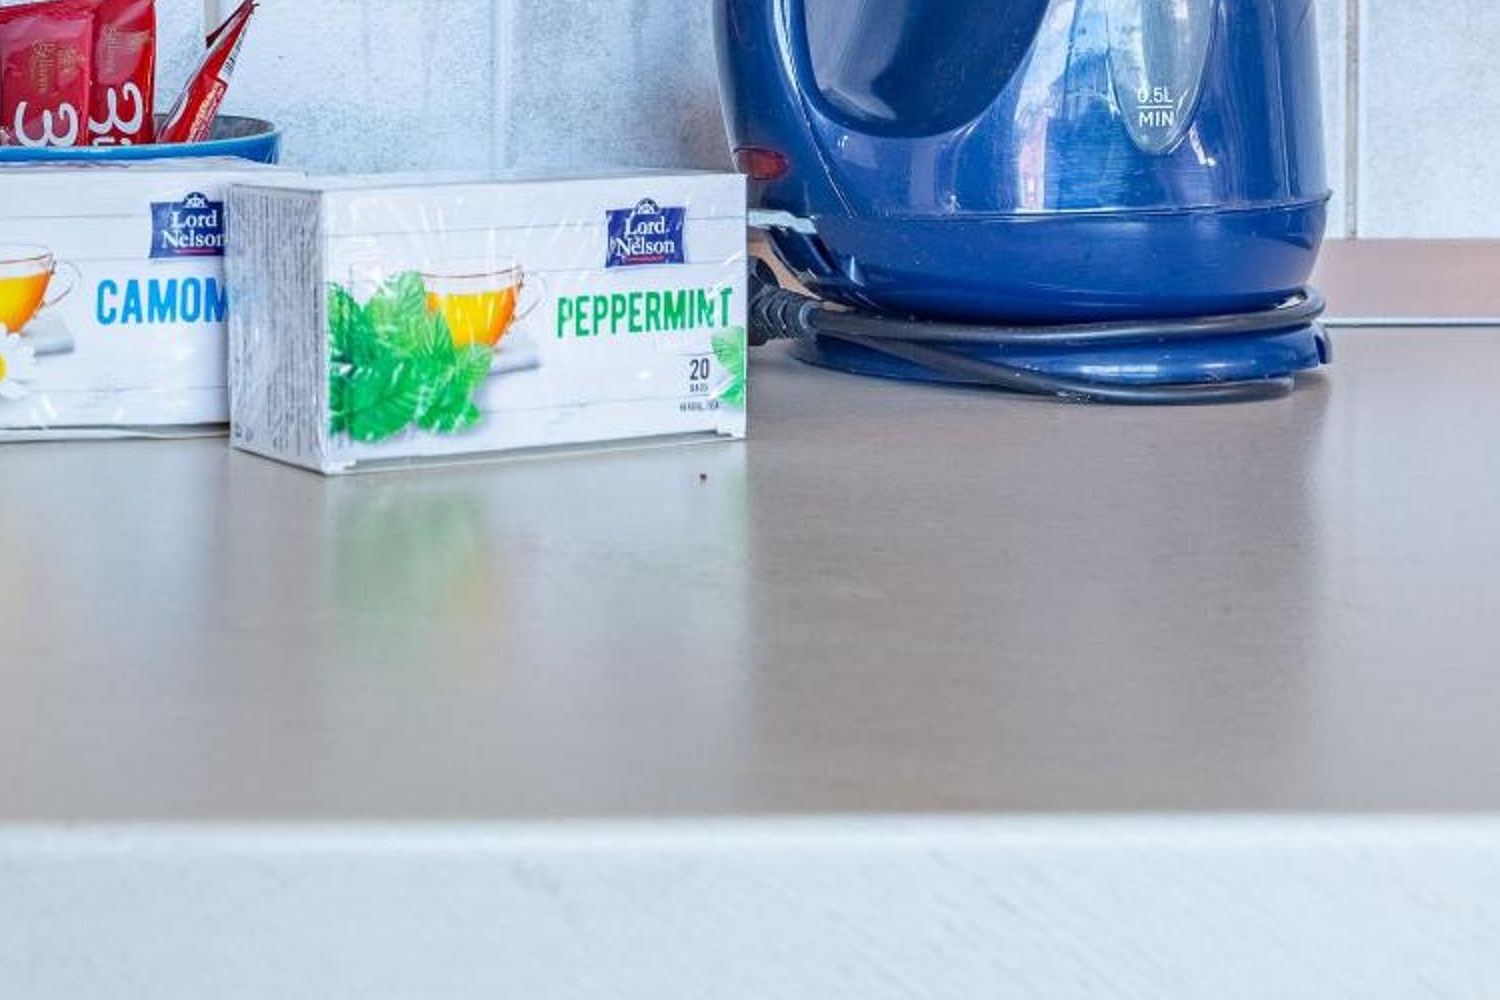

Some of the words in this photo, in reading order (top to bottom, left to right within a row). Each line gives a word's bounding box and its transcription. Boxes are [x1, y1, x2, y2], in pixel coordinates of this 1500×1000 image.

[1139, 112, 1174, 127] MIN
[170, 210, 217, 229] Lord
[624, 215, 667, 235] Lord
[616, 238, 675, 256] Nelson
[557, 287, 733, 338] PEPPERMINT
[689, 358, 710, 381] 20
